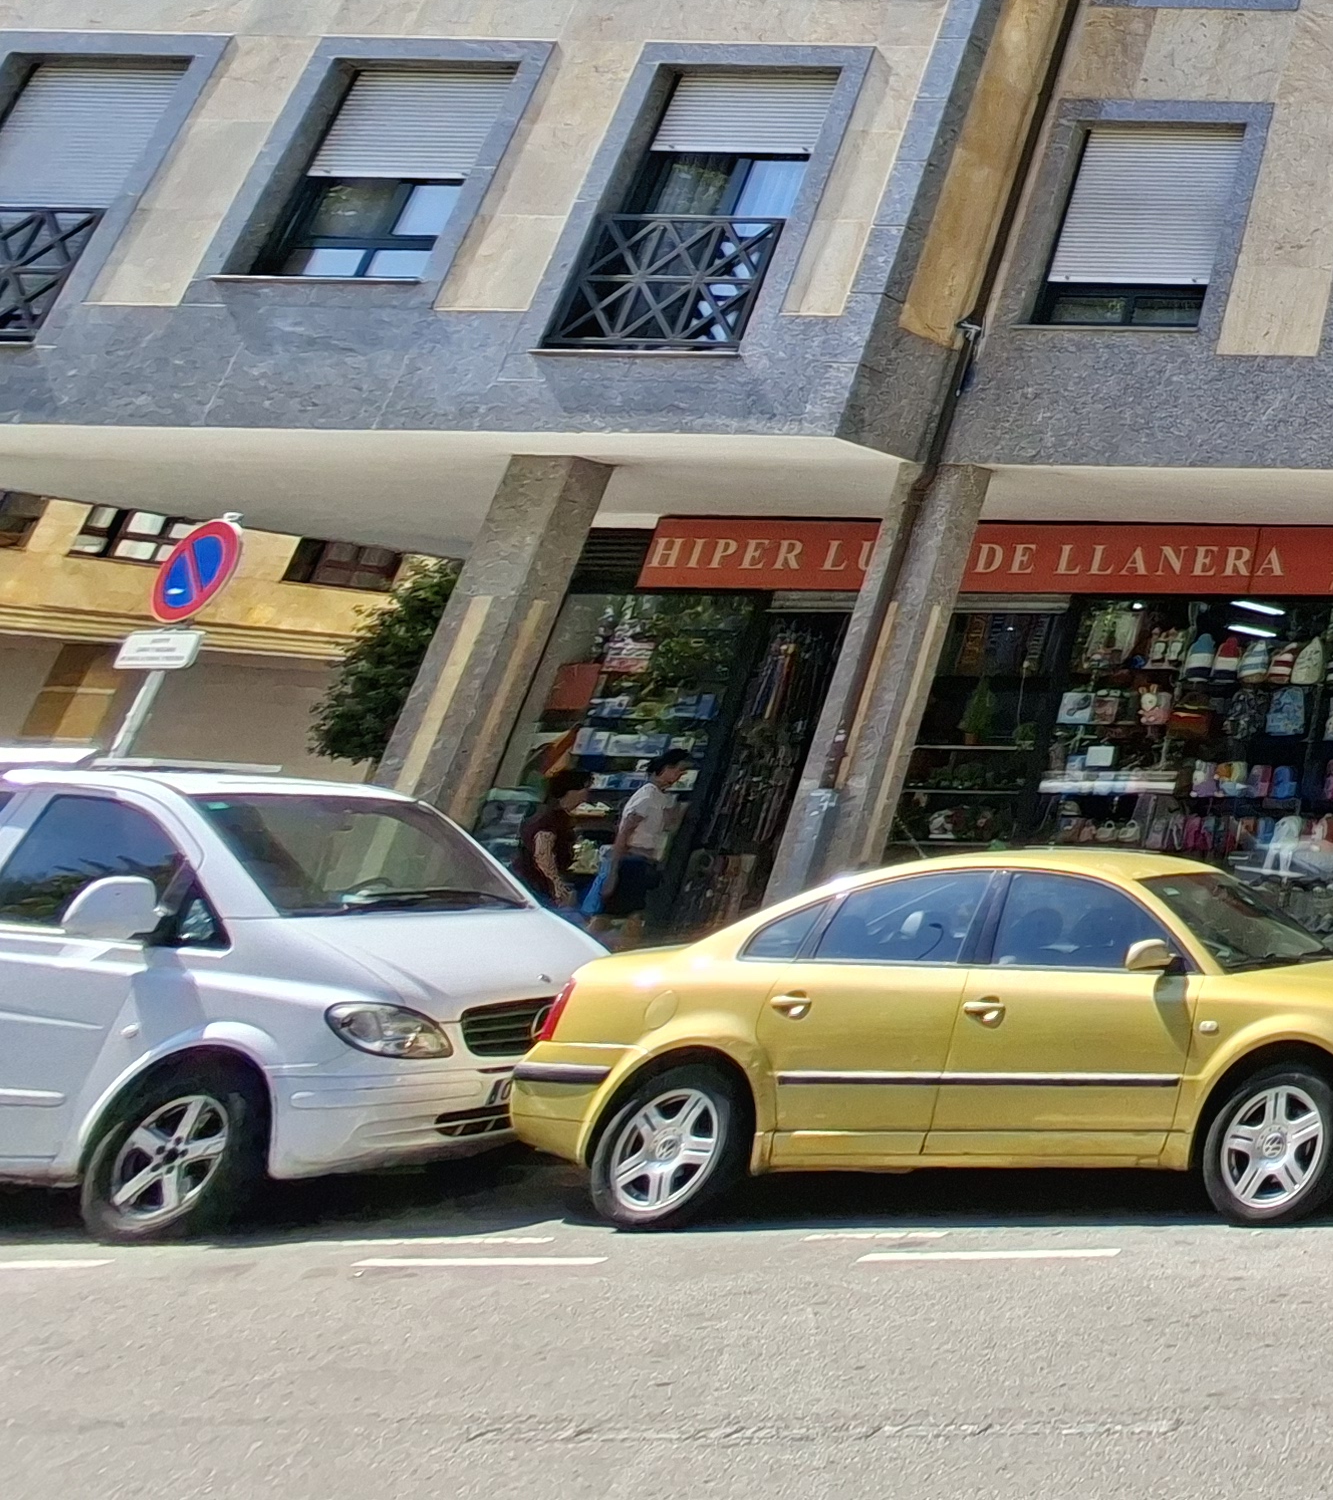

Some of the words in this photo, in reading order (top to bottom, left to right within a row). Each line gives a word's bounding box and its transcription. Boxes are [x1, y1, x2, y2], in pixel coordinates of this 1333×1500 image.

[646, 537, 804, 571] HIPER
[971, 543, 1037, 575] DE
[1053, 544, 1285, 577] LLANERA
